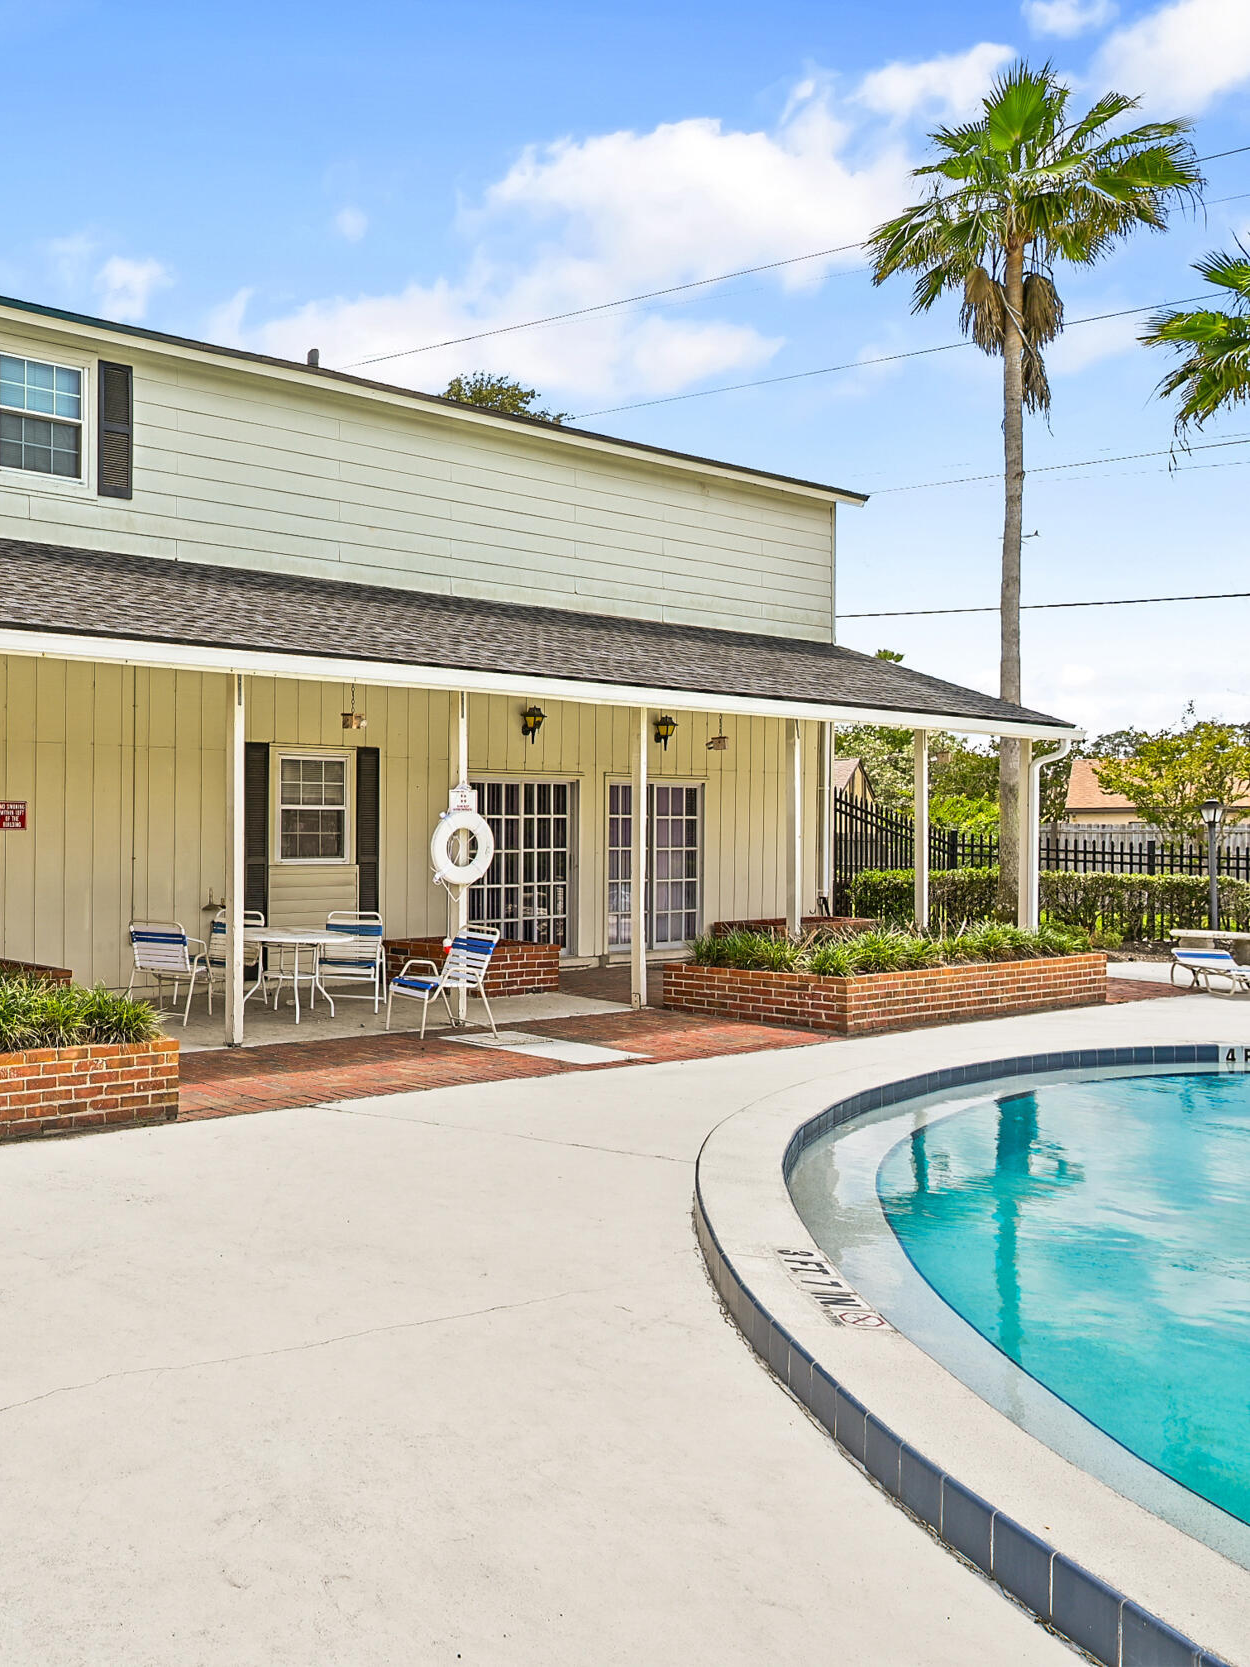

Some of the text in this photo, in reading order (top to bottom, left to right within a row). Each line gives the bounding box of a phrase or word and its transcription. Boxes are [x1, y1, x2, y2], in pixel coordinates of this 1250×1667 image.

[1225, 1048, 1236, 1062] 4
[777, 1249, 815, 1257] 3
[801, 1279, 843, 1288] 7
